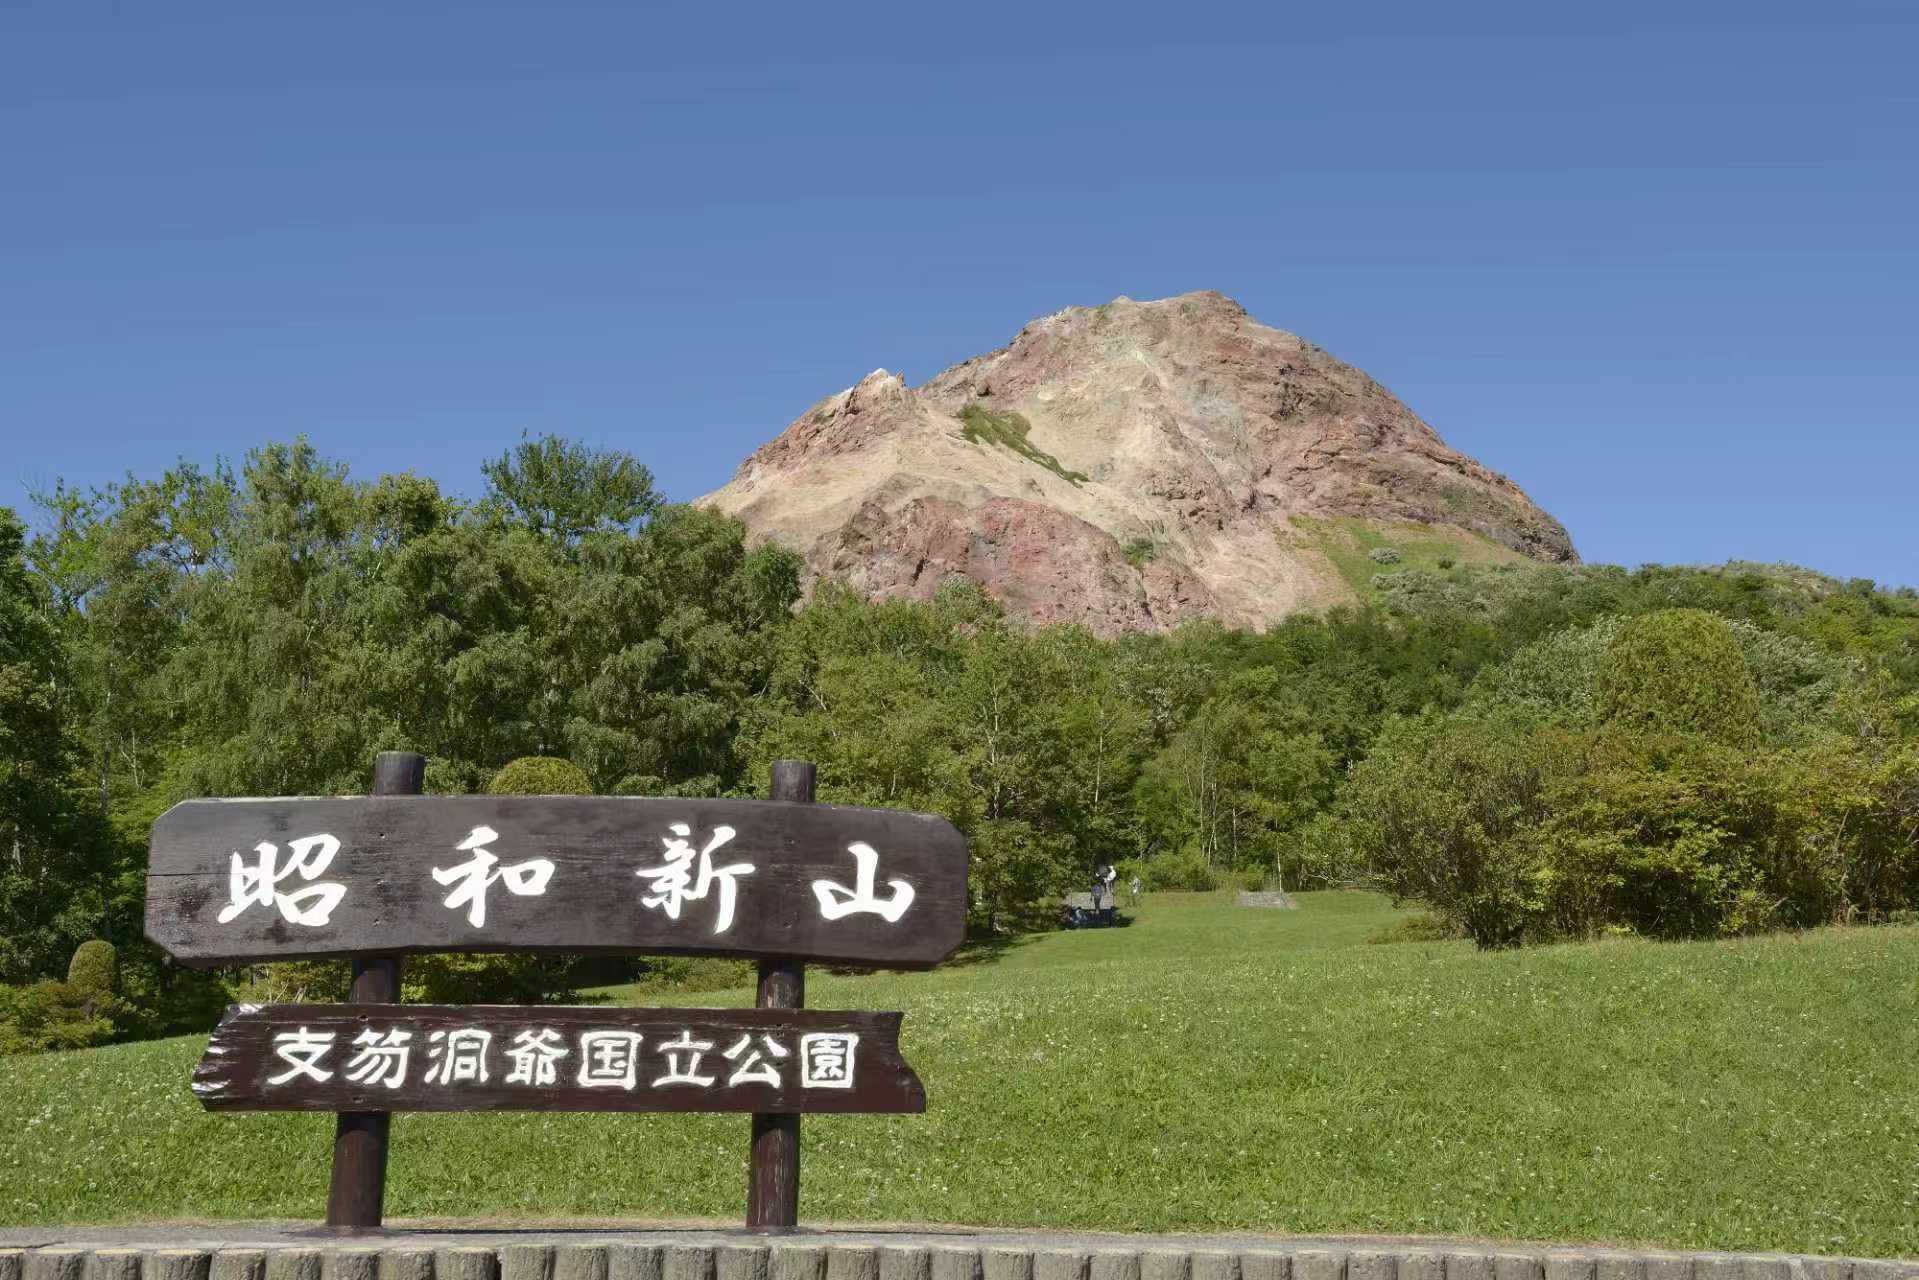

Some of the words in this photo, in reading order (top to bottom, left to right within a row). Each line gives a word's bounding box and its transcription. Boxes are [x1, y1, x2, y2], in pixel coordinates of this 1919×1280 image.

[217, 823, 916, 934] 昭和新山
[267, 1026, 860, 1090] 支笏洞爺国立公園
